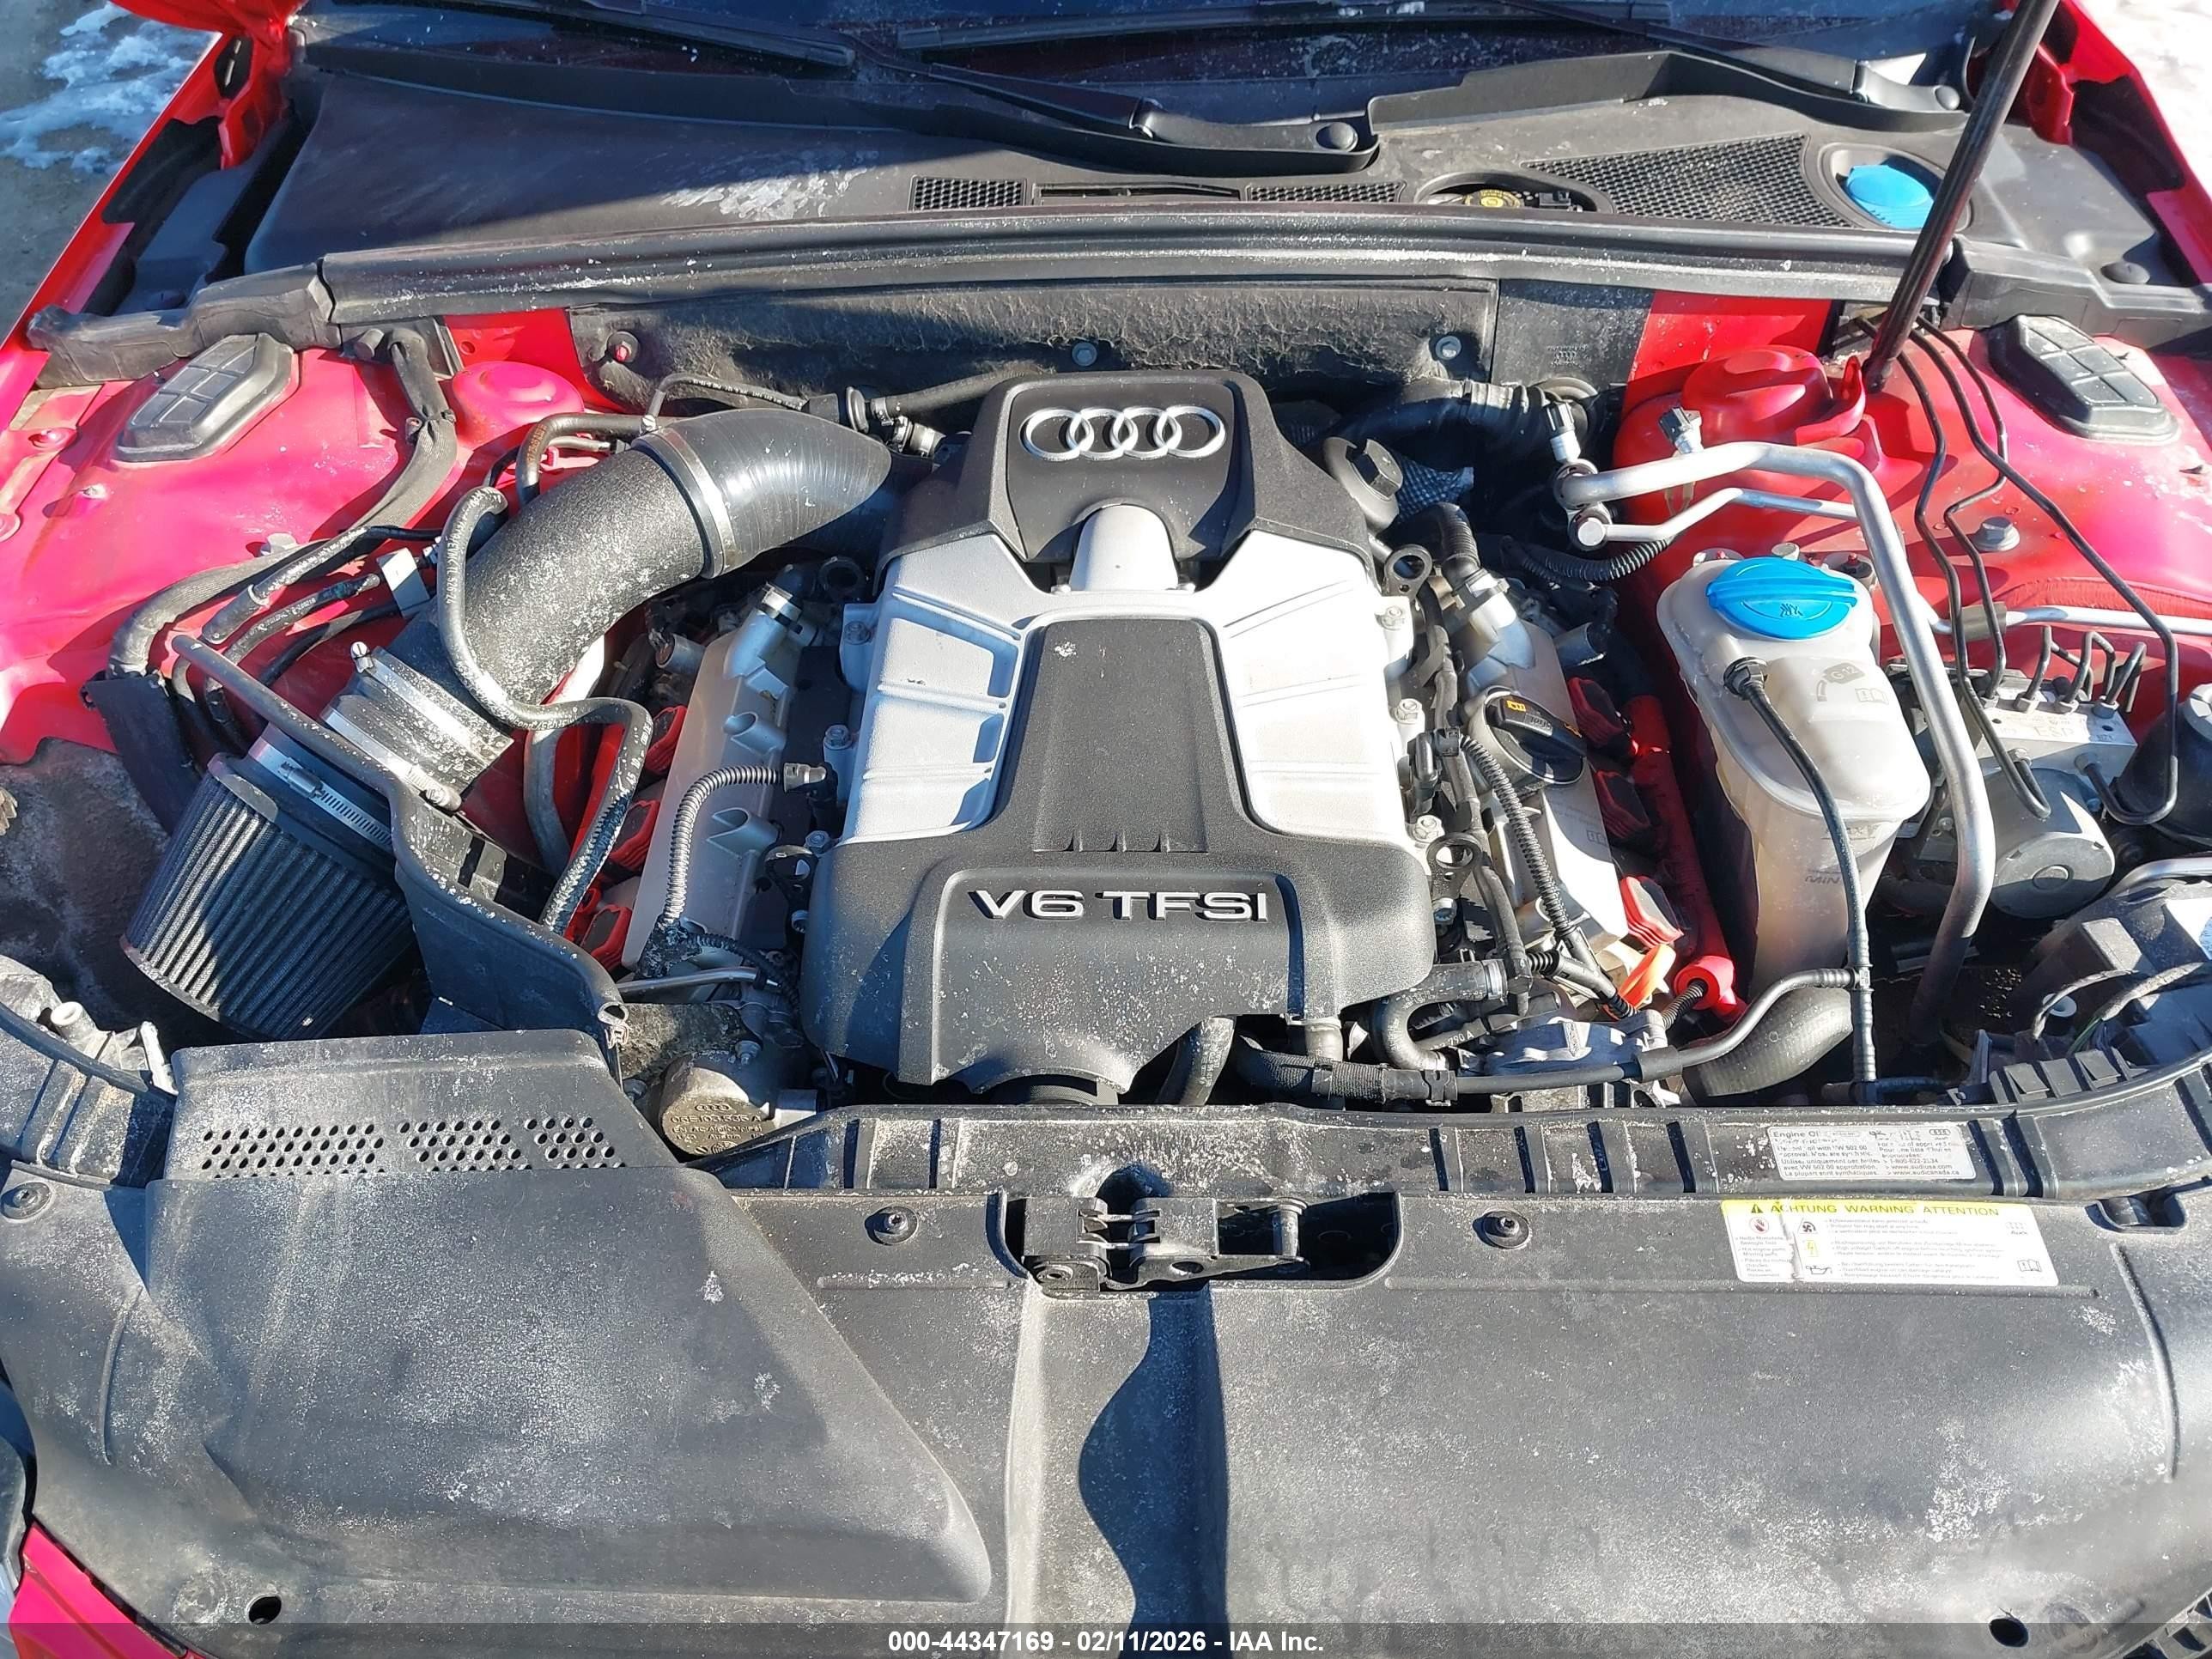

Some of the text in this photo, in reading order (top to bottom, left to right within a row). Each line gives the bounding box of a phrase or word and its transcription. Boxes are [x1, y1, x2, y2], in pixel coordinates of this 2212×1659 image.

[1831, 666, 1859, 679] G12
[975, 890, 1267, 922] V6 TFSI
[1448, 1033, 1464, 1046] 790
[1466, 1030, 1474, 1040] A
[1846, 1204, 1915, 1214] WARNING
[1923, 1206, 2000, 1216] ATTENTION
